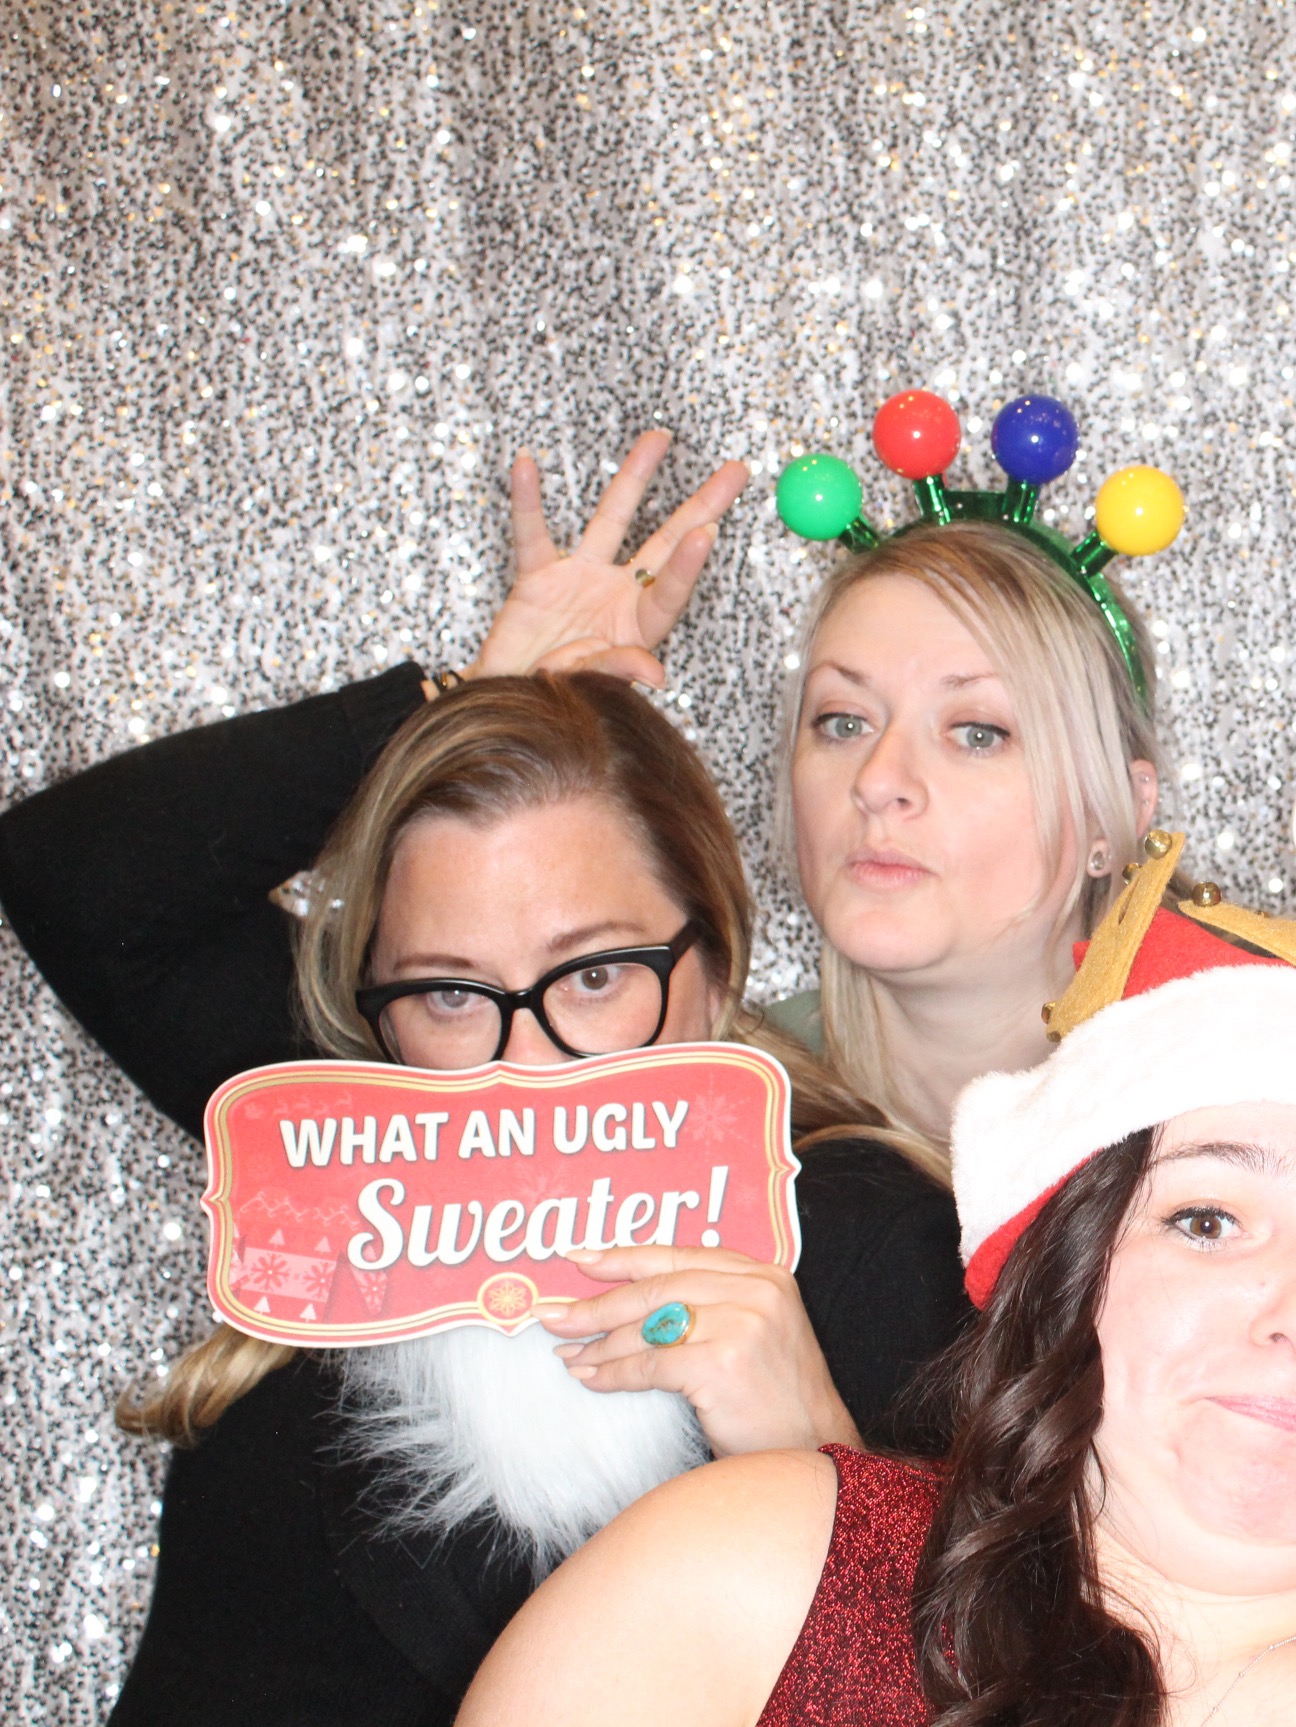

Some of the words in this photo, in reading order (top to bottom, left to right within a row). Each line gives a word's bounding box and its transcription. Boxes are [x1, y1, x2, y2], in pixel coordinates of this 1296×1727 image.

[279, 1111, 450, 1168] WHAT
[457, 1107, 535, 1158] AN
[552, 1100, 689, 1154] UGLY
[346, 1165, 730, 1271] Sweater!
